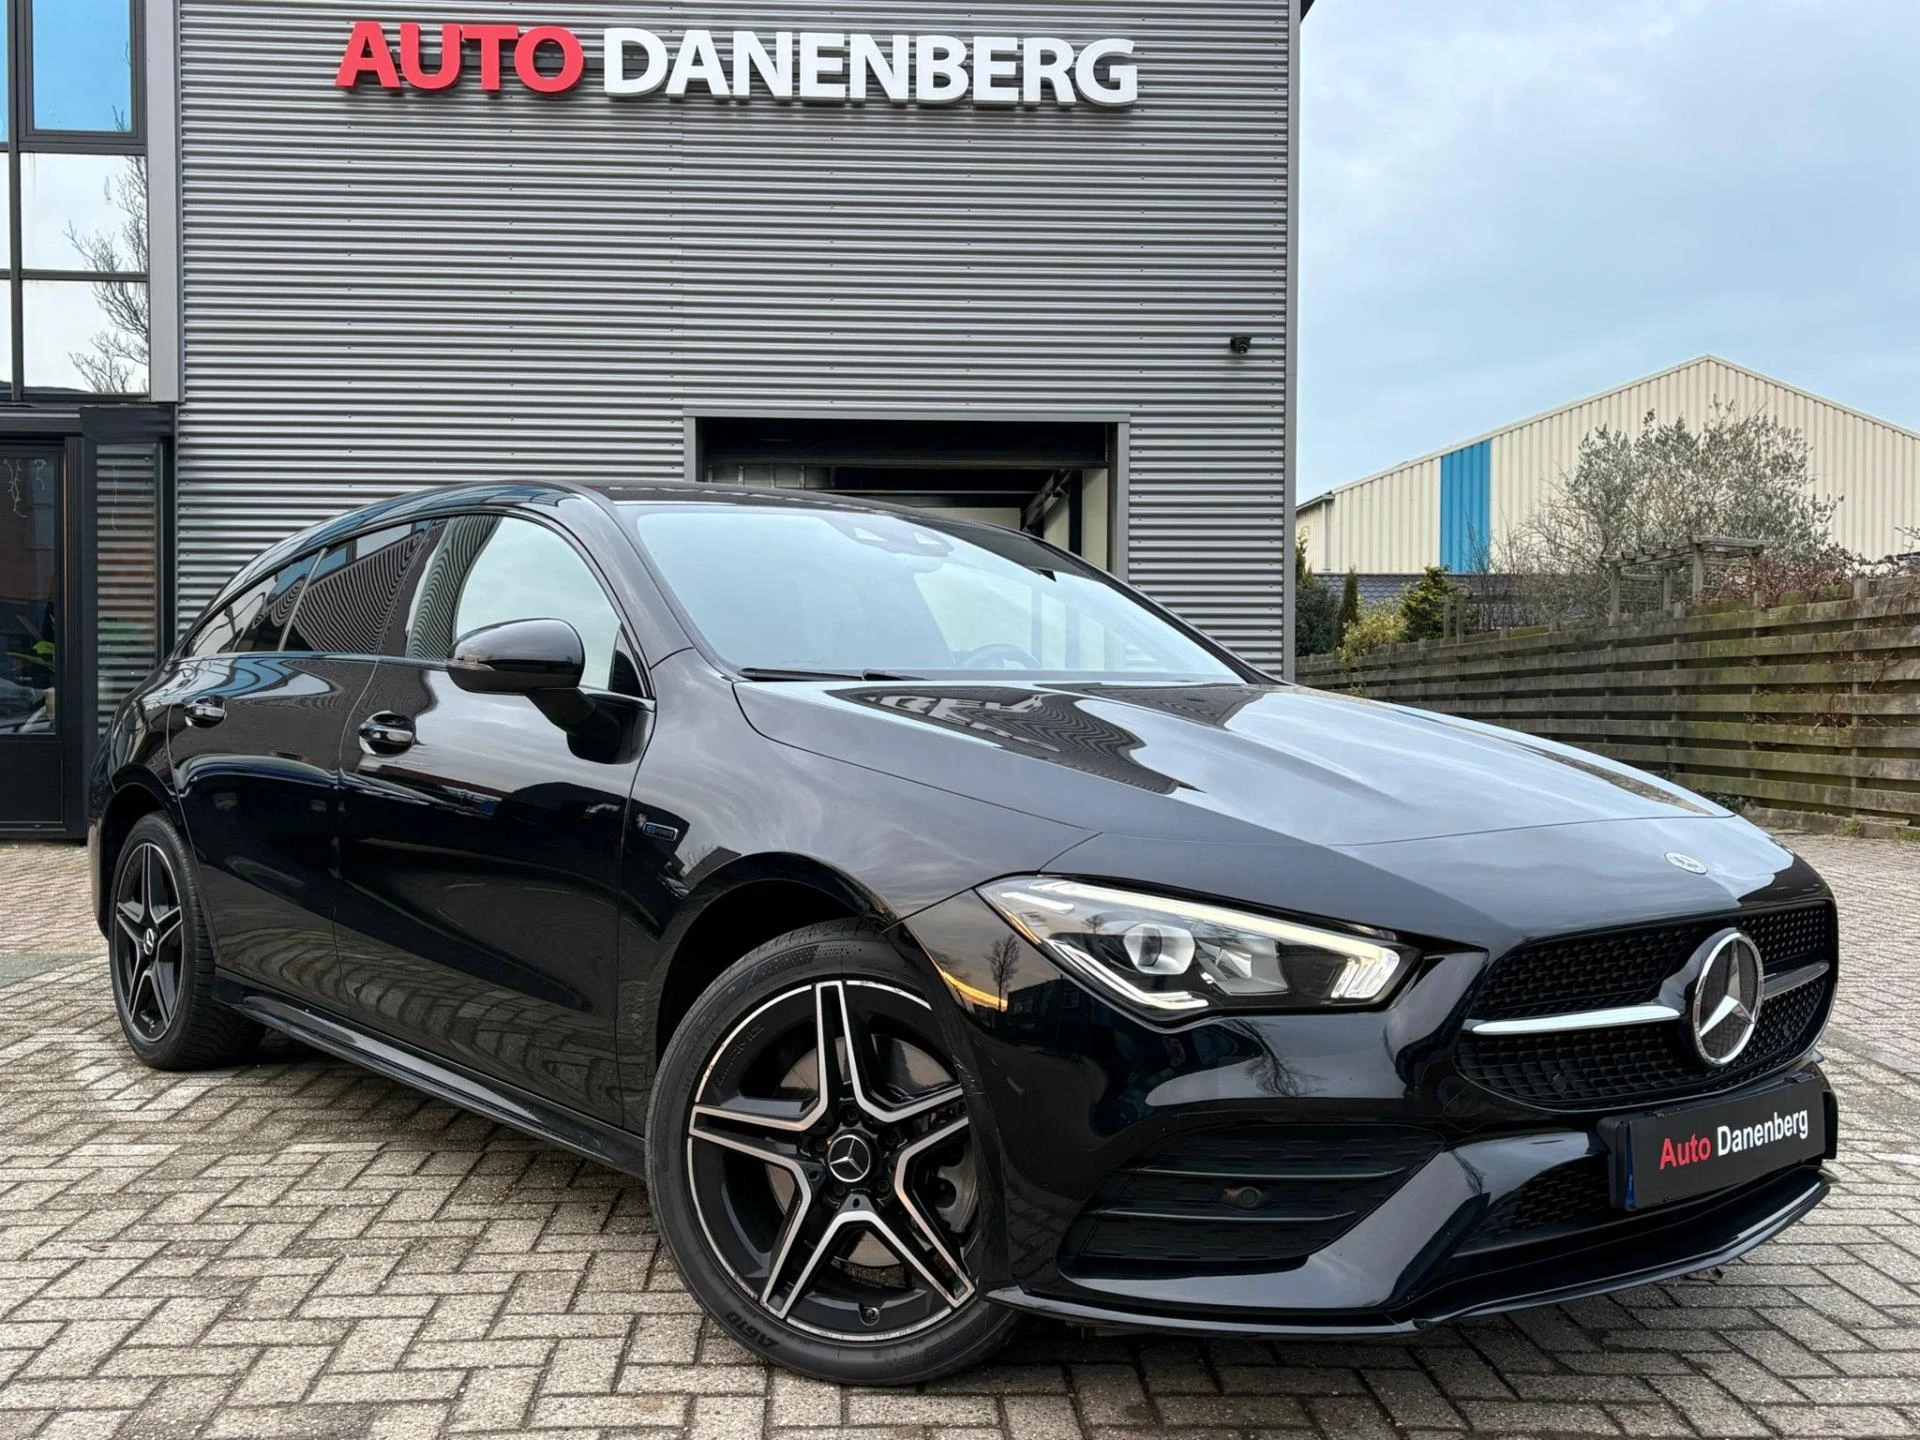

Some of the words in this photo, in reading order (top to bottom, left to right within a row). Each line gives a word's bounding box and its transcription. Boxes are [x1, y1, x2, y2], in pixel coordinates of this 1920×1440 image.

[336, 21, 586, 94] AUTO
[603, 28, 1139, 106] DANENBERG
[1659, 1133, 1712, 1170] Auto
[1716, 1109, 1809, 1157] Danenberg
